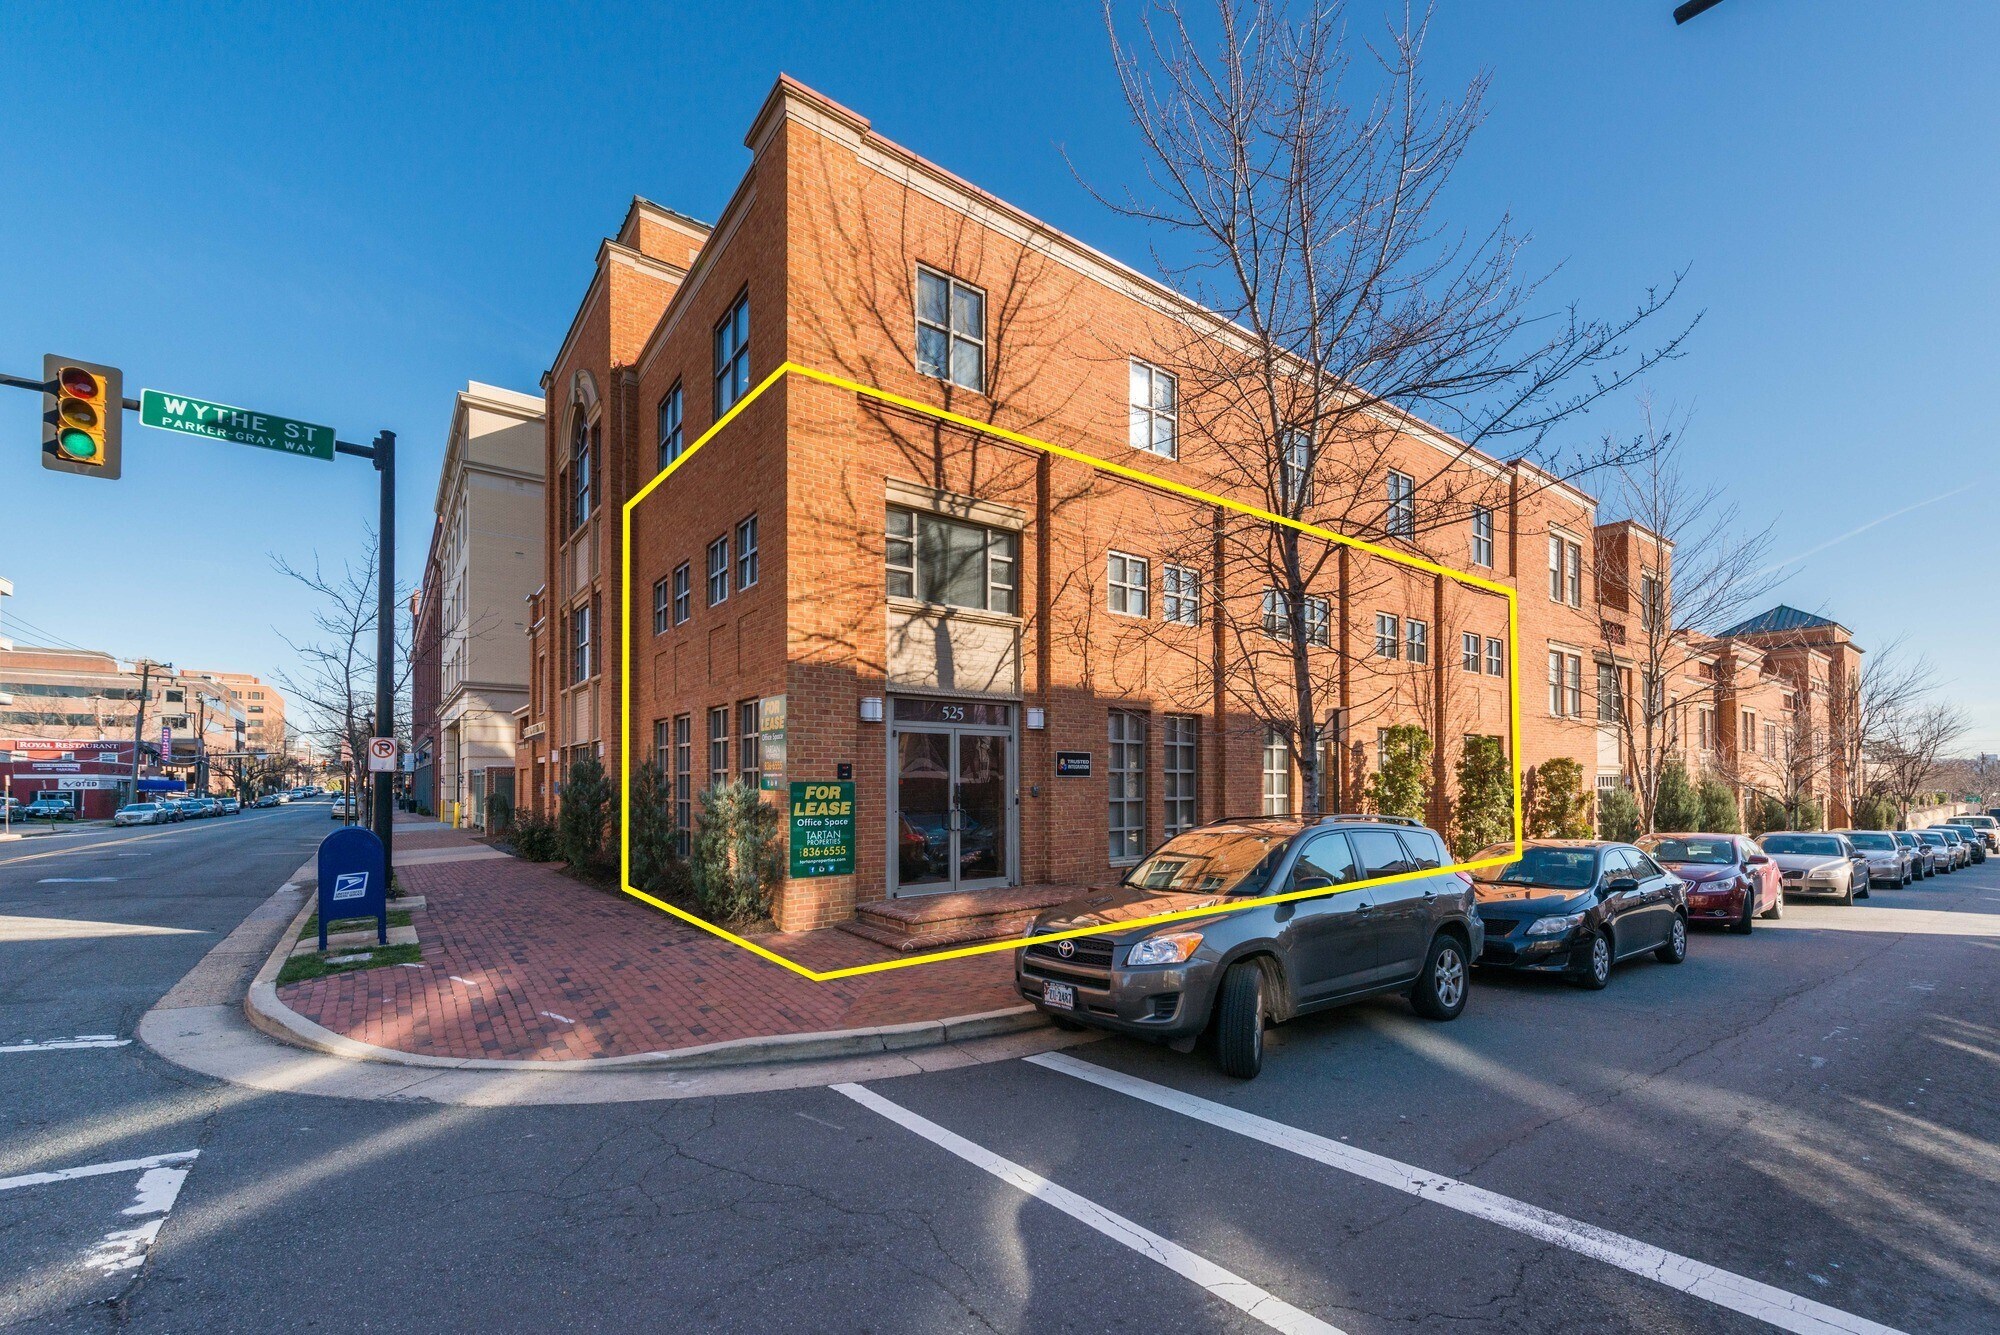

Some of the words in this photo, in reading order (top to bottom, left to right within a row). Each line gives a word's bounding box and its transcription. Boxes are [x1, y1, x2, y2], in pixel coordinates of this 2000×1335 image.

[163, 397, 268, 433] WYTHE
[284, 422, 318, 442] ST
[162, 417, 276, 446] PARKER-GRAY
[284, 440, 316, 454] WAY
[765, 700, 780, 715] FOR
[941, 706, 964, 721] 525
[760, 715, 785, 732] LEASE
[20, 741, 53, 749] ROYAL
[55, 741, 119, 749] RESTAURANT
[804, 786, 842, 800] FOR
[793, 801, 852, 817] LEASE
[797, 818, 822, 827] Office
[824, 818, 849, 827] Space
[806, 830, 841, 840] TARTAN
